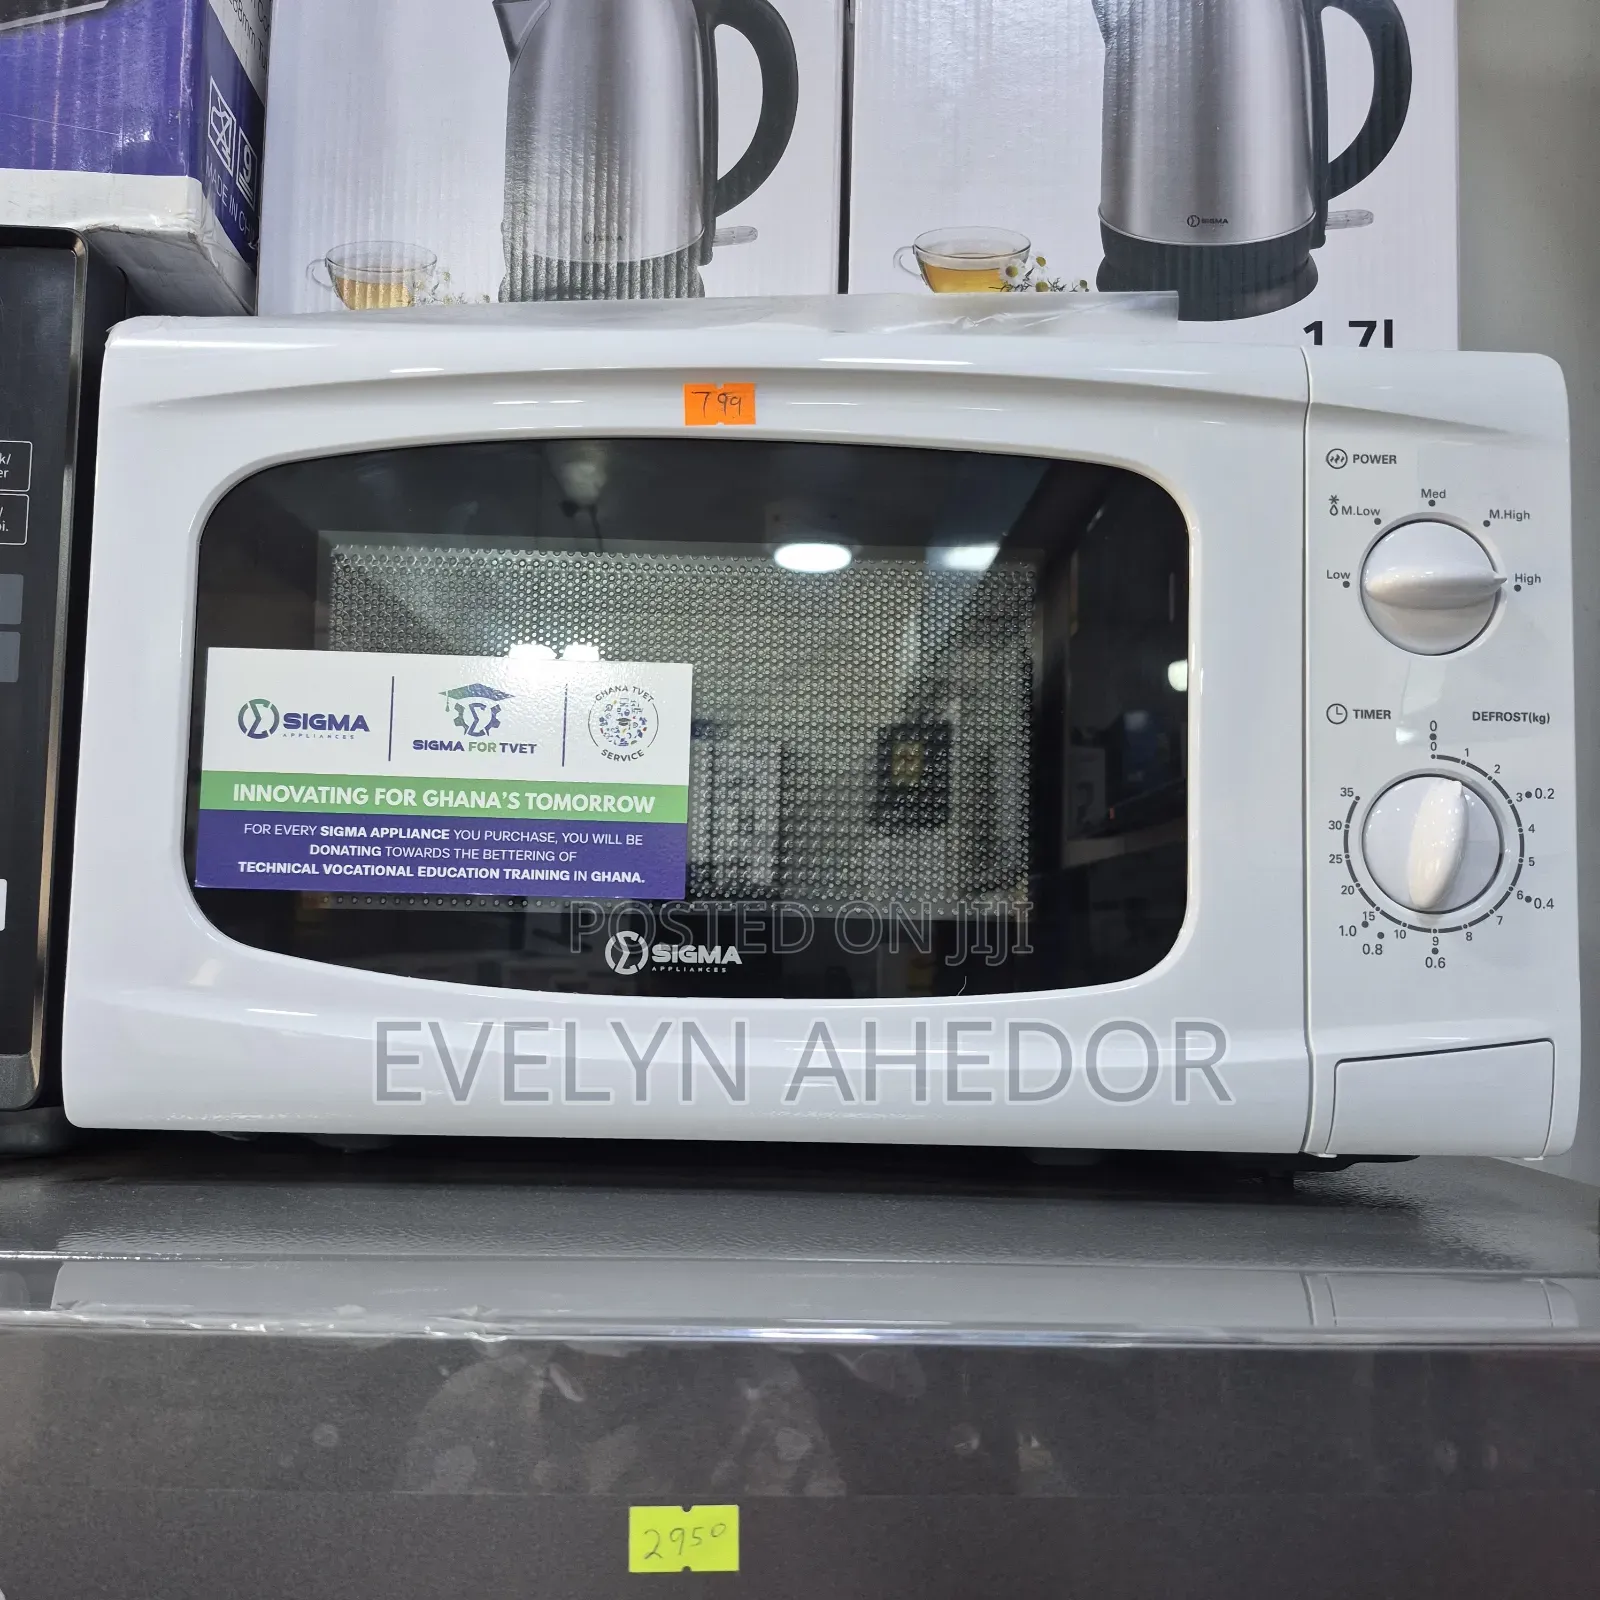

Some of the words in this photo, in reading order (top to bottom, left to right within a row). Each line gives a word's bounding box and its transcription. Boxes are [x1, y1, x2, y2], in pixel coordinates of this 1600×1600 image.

[205, 155, 229, 207] MADE
[229, 194, 239, 221] IN
[691, 391, 742, 419] 799
[1352, 454, 1397, 465] POWER
[1421, 488, 1446, 499] Med
[1341, 506, 1381, 516] M.Low
[1489, 510, 1531, 521] M.High
[1326, 570, 1351, 580] Low
[1515, 573, 1542, 585] High
[595, 684, 629, 702] GHANA
[632, 686, 654, 703] TVET
[1353, 709, 1392, 720] TIMER
[1472, 711, 1551, 725] DEFROST(kg)
[282, 712, 370, 733] SIGMA
[1429, 720, 1437, 732] 0
[412, 739, 465, 752] SIGMA
[468, 741, 496, 753] FOR
[499, 742, 537, 754] TVET
[1430, 742, 1437, 752] 0
[600, 749, 645, 762] SERVICE
[1464, 748, 1469, 757] 1
[1494, 764, 1501, 774] 2
[1340, 787, 1354, 798] 35
[1516, 793, 1523, 803] 3
[1534, 788, 1555, 800] 0.2
[233, 783, 369, 805] INNOVATING
[374, 787, 418, 807] FOR
[525, 793, 655, 814] TOMORROW
[1328, 820, 1343, 831] 30
[1528, 824, 1535, 833] 4
[244, 823, 271, 835] FOR
[274, 824, 318, 836] EVERY
[319, 825, 368, 838] SIGMA
[370, 827, 450, 840] APPLIANCE
[453, 829, 481, 841] YOU
[484, 830, 558, 845] PURCHASE,
[562, 832, 589, 844] YOU
[592, 833, 622, 845] WILL
[626, 834, 643, 846] BE
[309, 844, 382, 857] DONATING
[385, 846, 450, 859] TOWARDS
[453, 848, 479, 860] THE
[482, 849, 555, 862] BETTERING
[559, 851, 577, 862] OF
[1328, 854, 1343, 864] 25
[1528, 857, 1535, 867] 5
[238, 861, 320, 875] TECHNICAL
[322, 863, 414, 877] VOCATIONAL
[417, 866, 500, 880] EDUCATION
[503, 868, 570, 881] TRAINING
[573, 870, 587, 882] IN
[590, 871, 646, 884] GHANA.
[1340, 885, 1355, 896] 20
[1516, 890, 1524, 900] 6
[1534, 897, 1555, 910] 0.4
[1363, 911, 1376, 921] 15
[1497, 916, 1504, 925] 7
[1339, 925, 1357, 937] 1.0
[1394, 929, 1407, 940] 10
[1465, 931, 1473, 942] 8
[1432, 936, 1439, 946] 9
[651, 943, 743, 965] SIGMA
[1362, 943, 1383, 956] 0.8
[1425, 957, 1446, 969] 0.6
[643, 1523, 727, 1560] 2950
